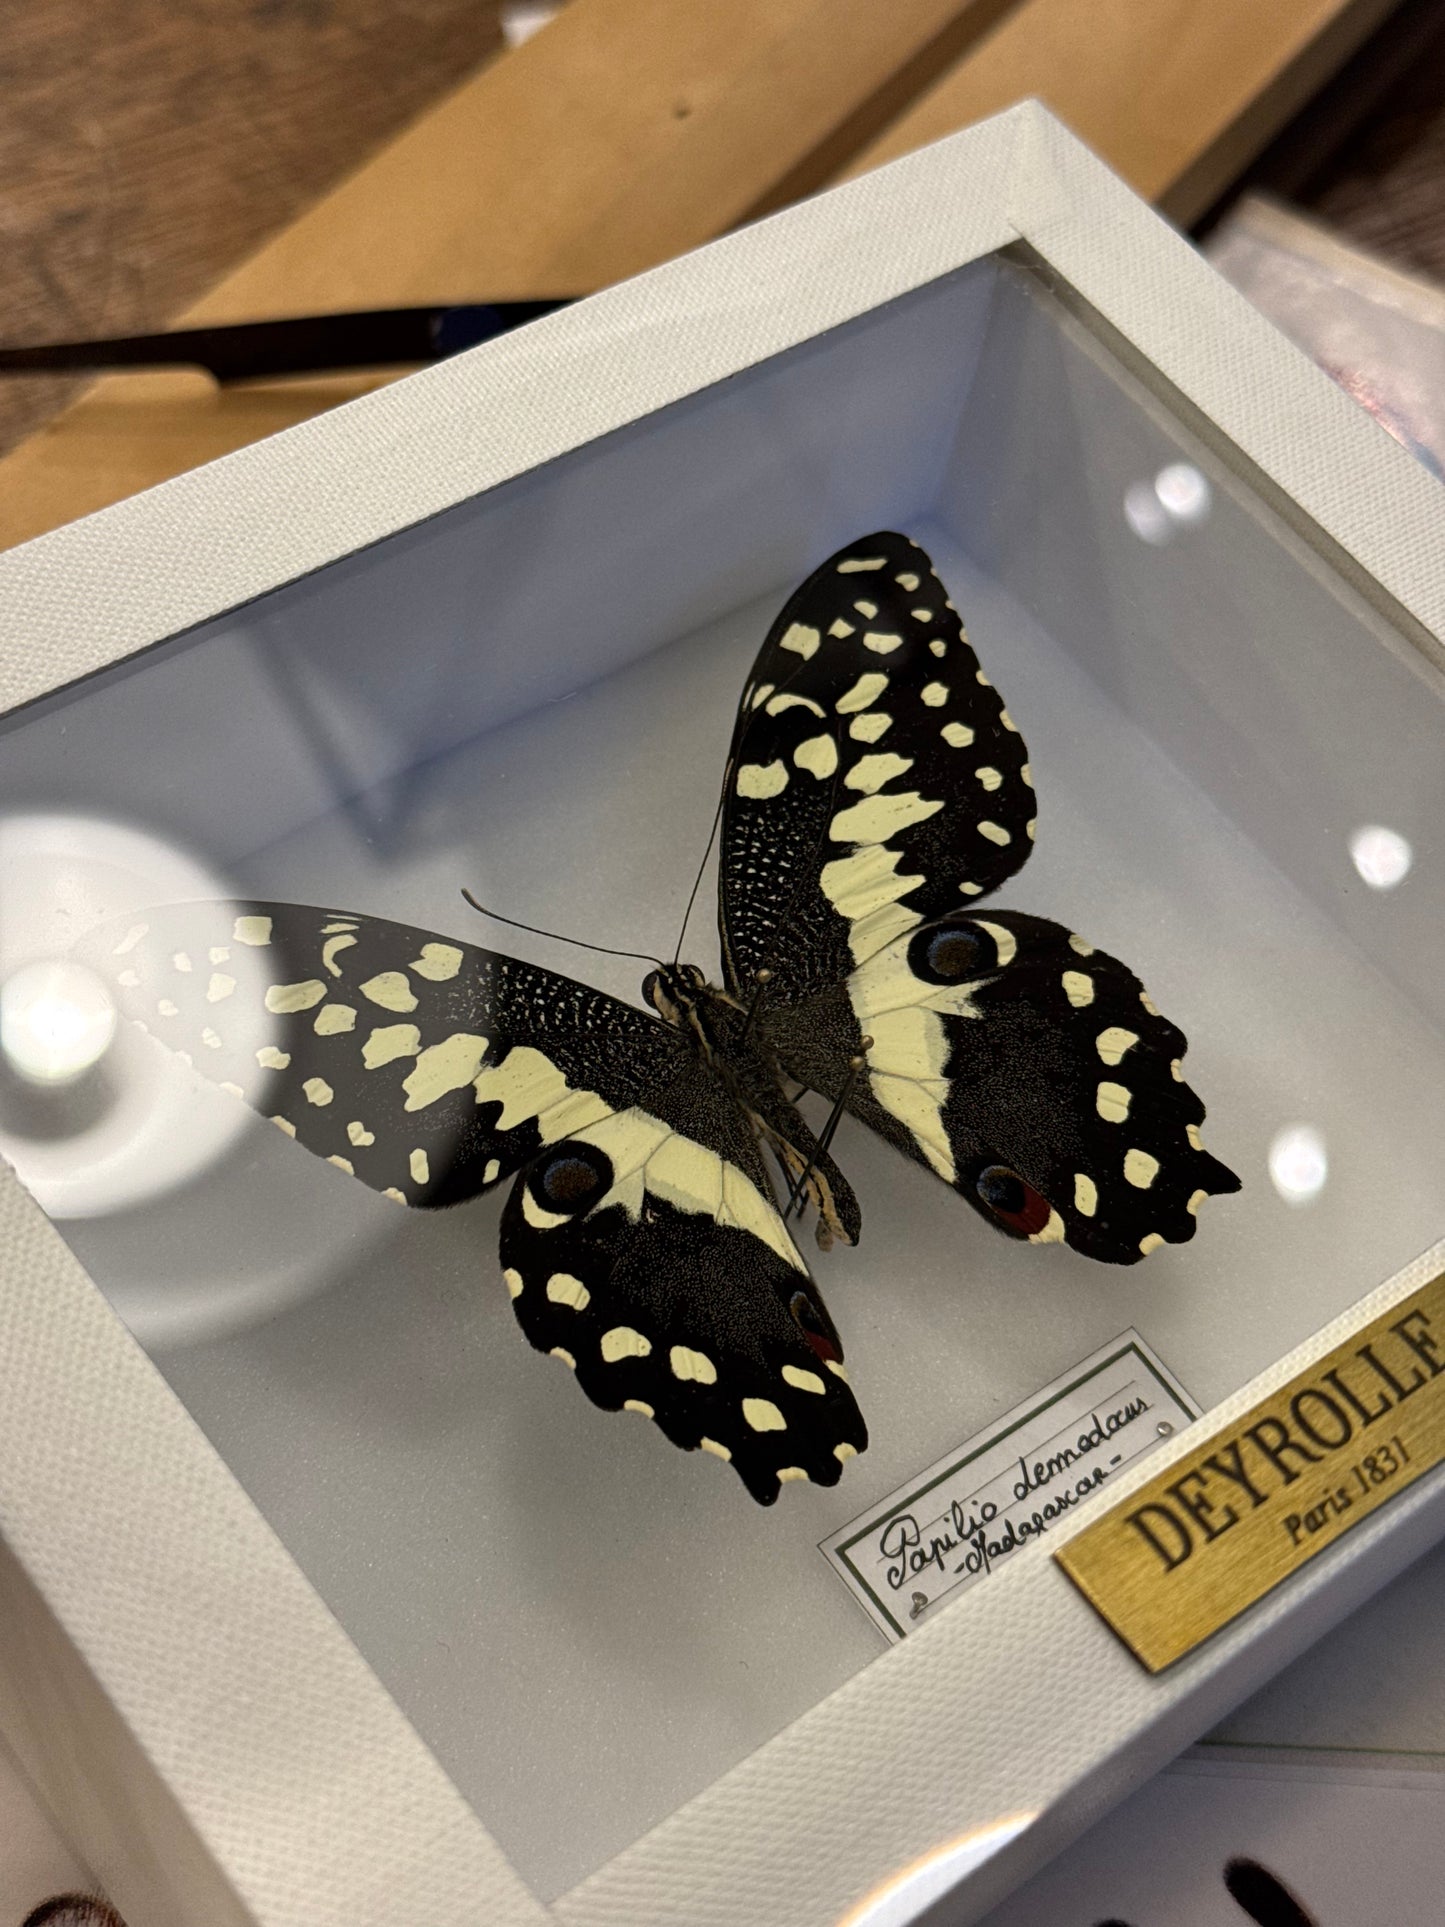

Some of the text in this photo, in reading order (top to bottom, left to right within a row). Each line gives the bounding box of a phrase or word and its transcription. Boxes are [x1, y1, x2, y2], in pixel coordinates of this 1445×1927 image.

[1123, 1309, 1445, 1574] DEYROLLE
[1282, 1436, 1411, 1547] Paris 1831
[879, 1500, 998, 1590] Papilio
